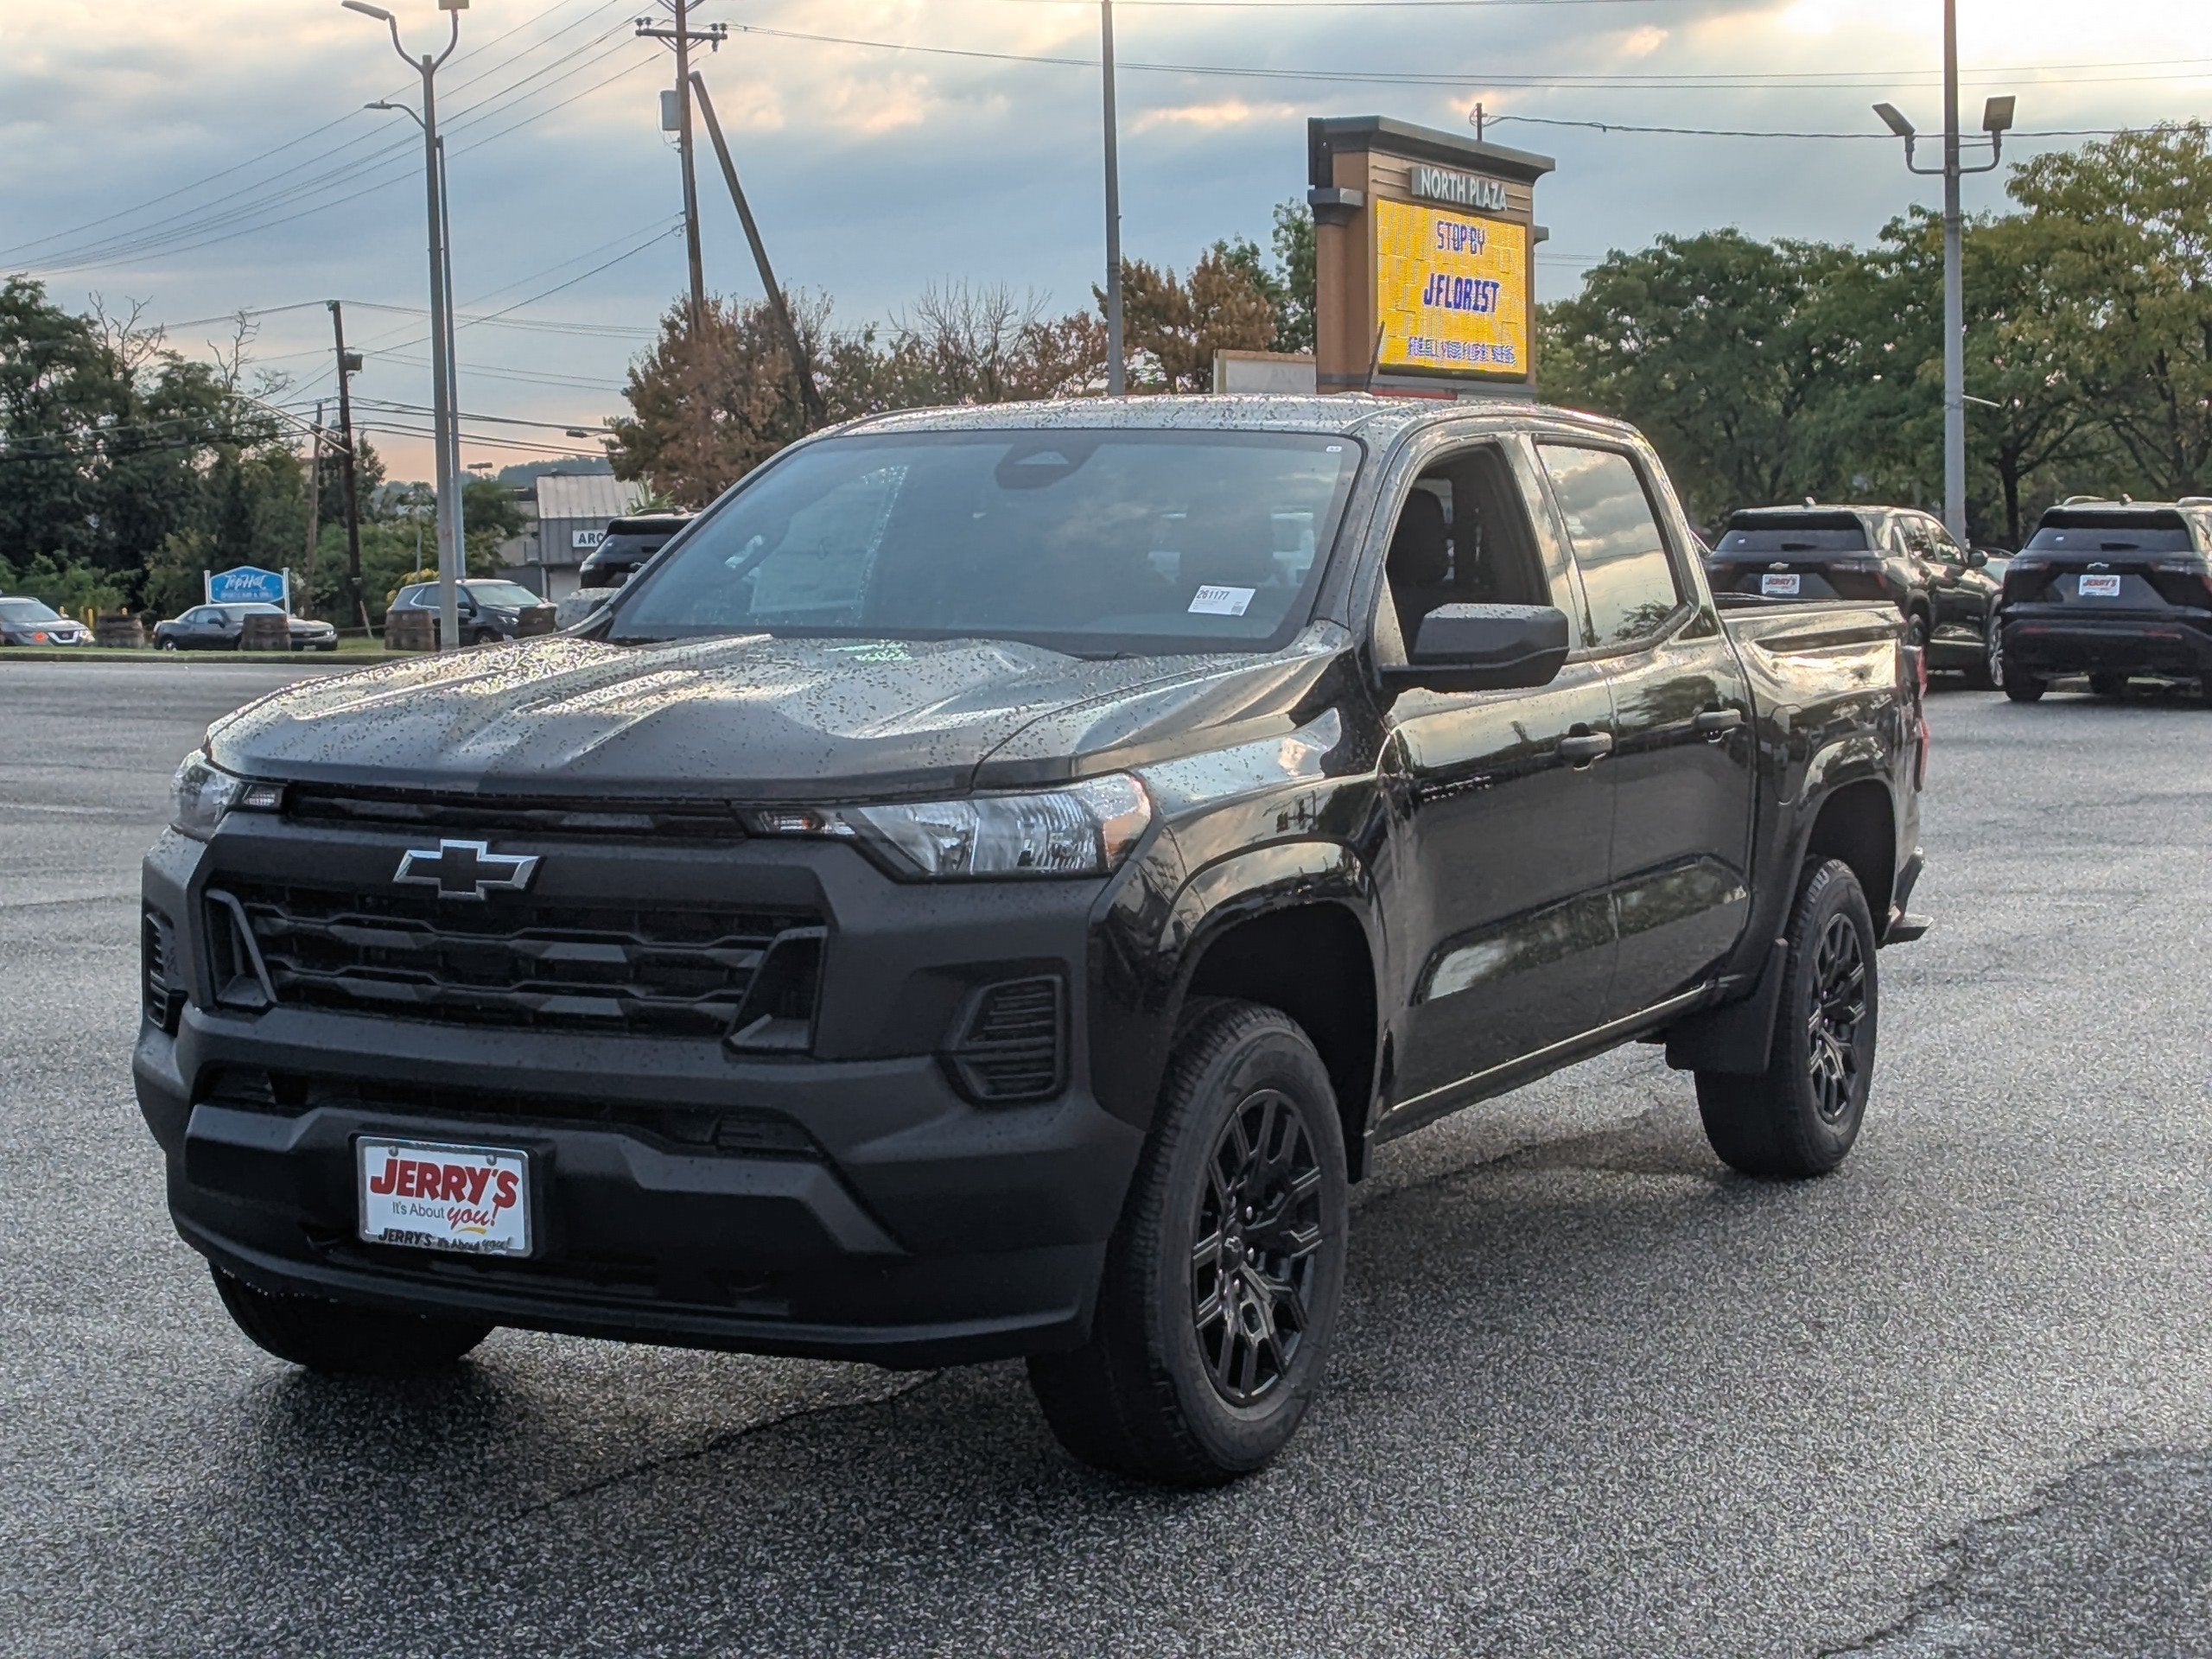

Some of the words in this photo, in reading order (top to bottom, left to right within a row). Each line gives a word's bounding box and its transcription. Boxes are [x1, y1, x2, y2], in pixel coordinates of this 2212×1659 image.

[1421, 168, 1465, 203] NORTH
[1470, 176, 1507, 211] PLAZA
[1436, 219, 1467, 251] STOP
[1470, 226, 1485, 255] BY
[1196, 589, 1230, 601] 261177
[370, 1158, 519, 1209] JERRY'S
[392, 1201, 407, 1215] It's
[410, 1203, 445, 1218] About
[447, 1204, 499, 1230] you!
[378, 1227, 432, 1247] JERRY'S
[451, 1238, 480, 1250] About
